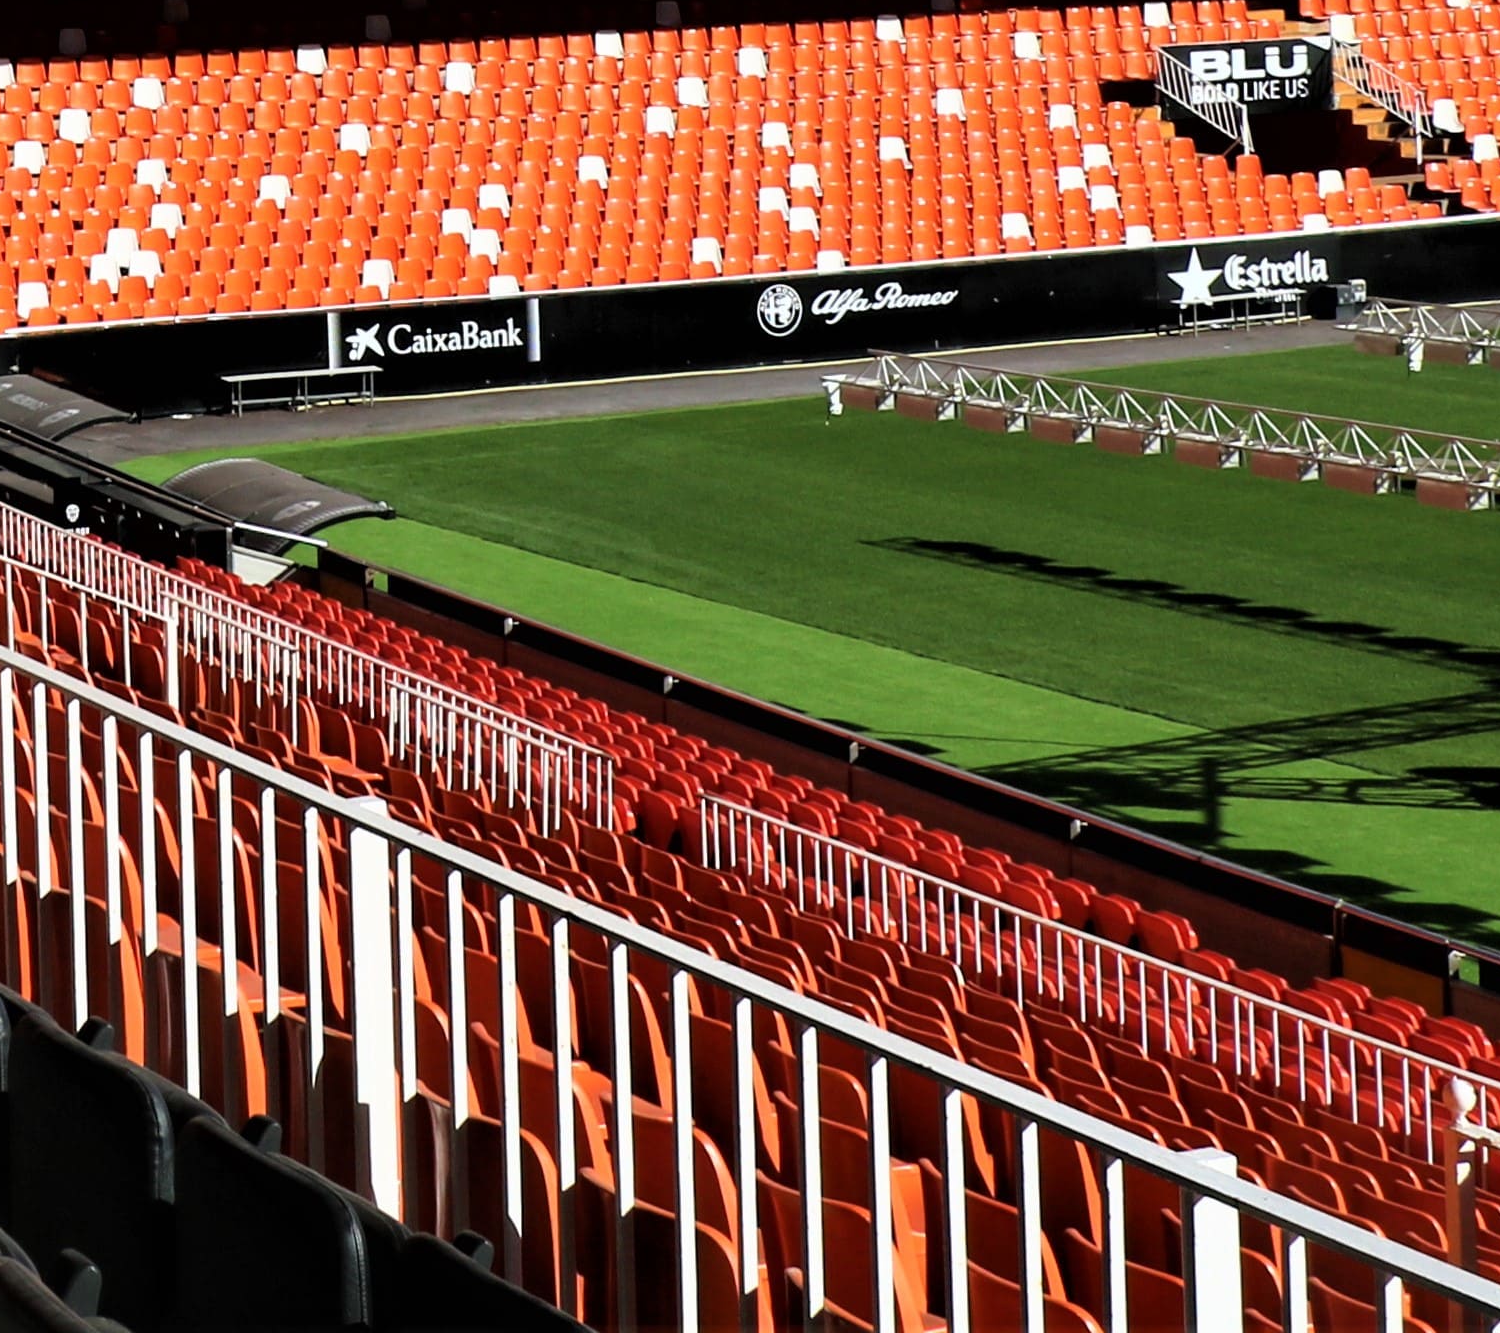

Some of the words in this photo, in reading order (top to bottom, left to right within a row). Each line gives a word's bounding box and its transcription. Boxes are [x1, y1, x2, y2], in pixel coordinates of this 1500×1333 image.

[1243, 79, 1281, 102] LIKE
[1284, 77, 1309, 99] US
[1223, 250, 1329, 290] Estrella
[811, 287, 871, 325] Alfa
[871, 282, 959, 310] Romeo
[388, 317, 524, 355] CaixaBank
